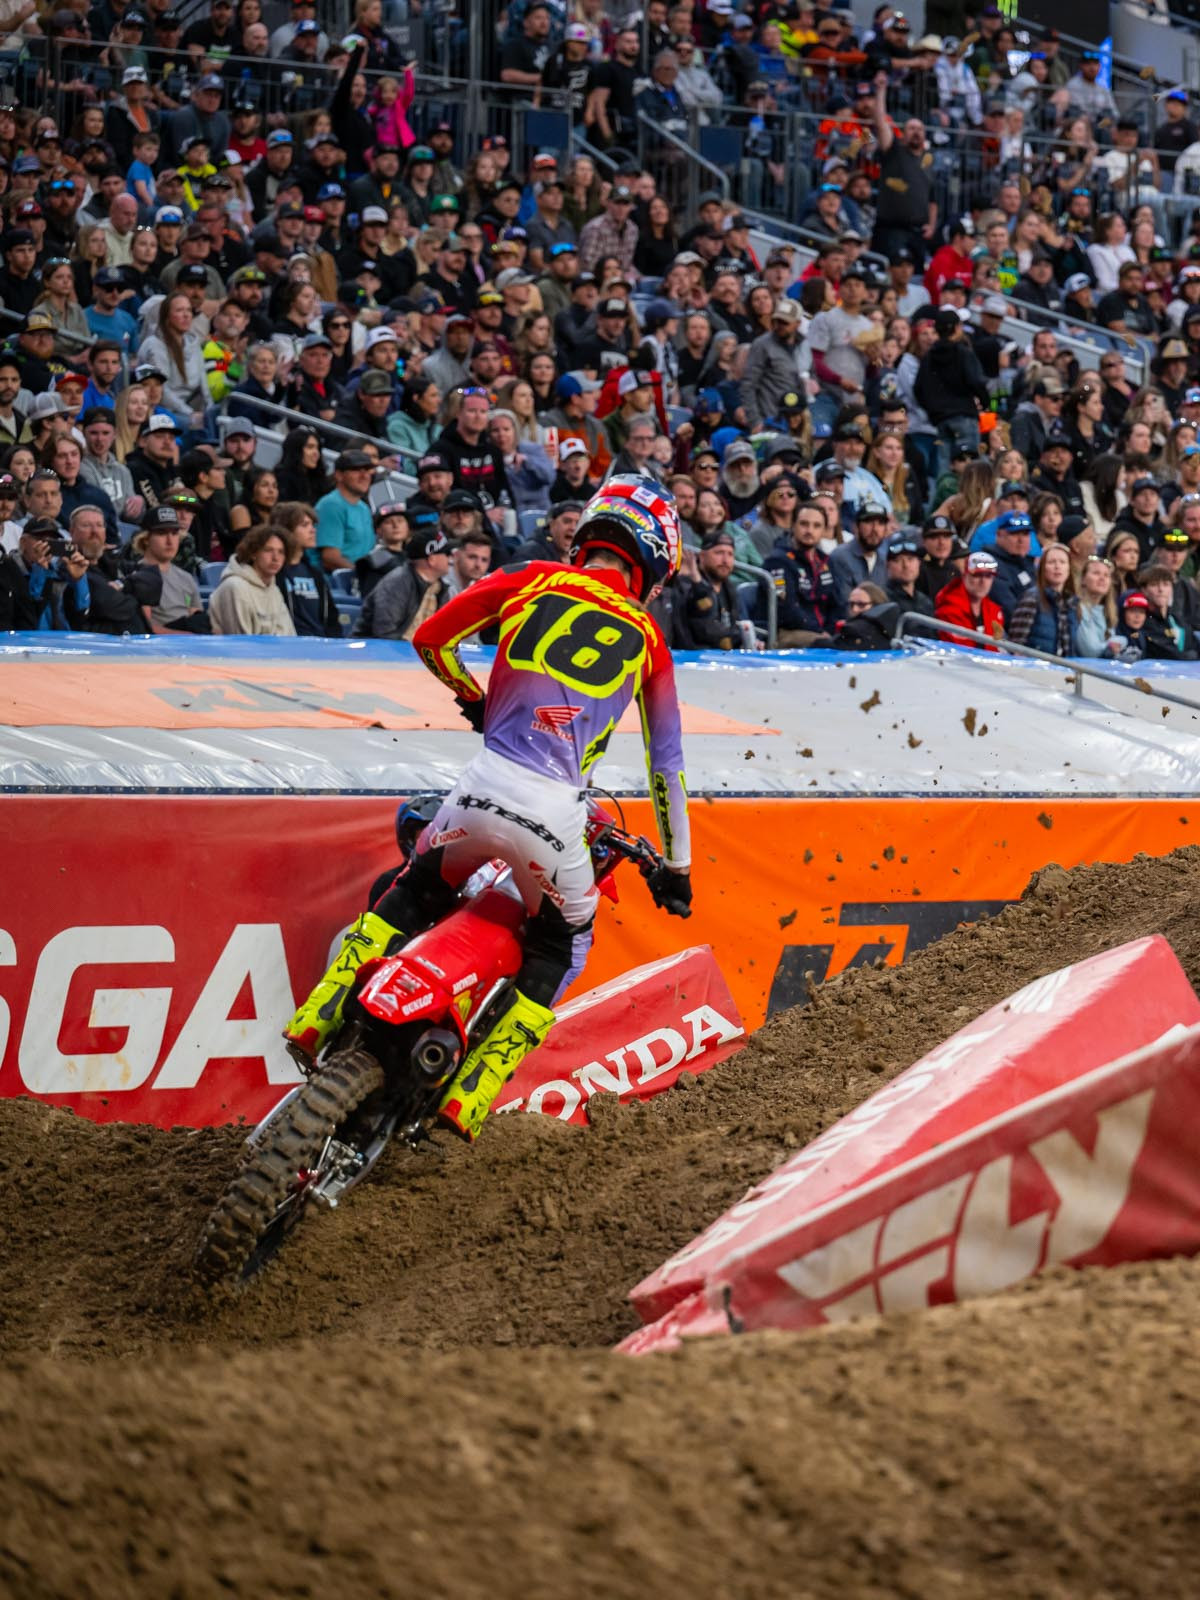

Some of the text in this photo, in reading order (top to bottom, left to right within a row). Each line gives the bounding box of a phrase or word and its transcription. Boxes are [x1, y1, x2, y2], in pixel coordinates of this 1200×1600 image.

[505, 590, 647, 690] 18
[455, 794, 566, 852] alpinestars
[0, 922, 309, 1095] GA
[402, 993, 433, 1017] DUNLOP
[496, 1004, 745, 1121] ONDA
